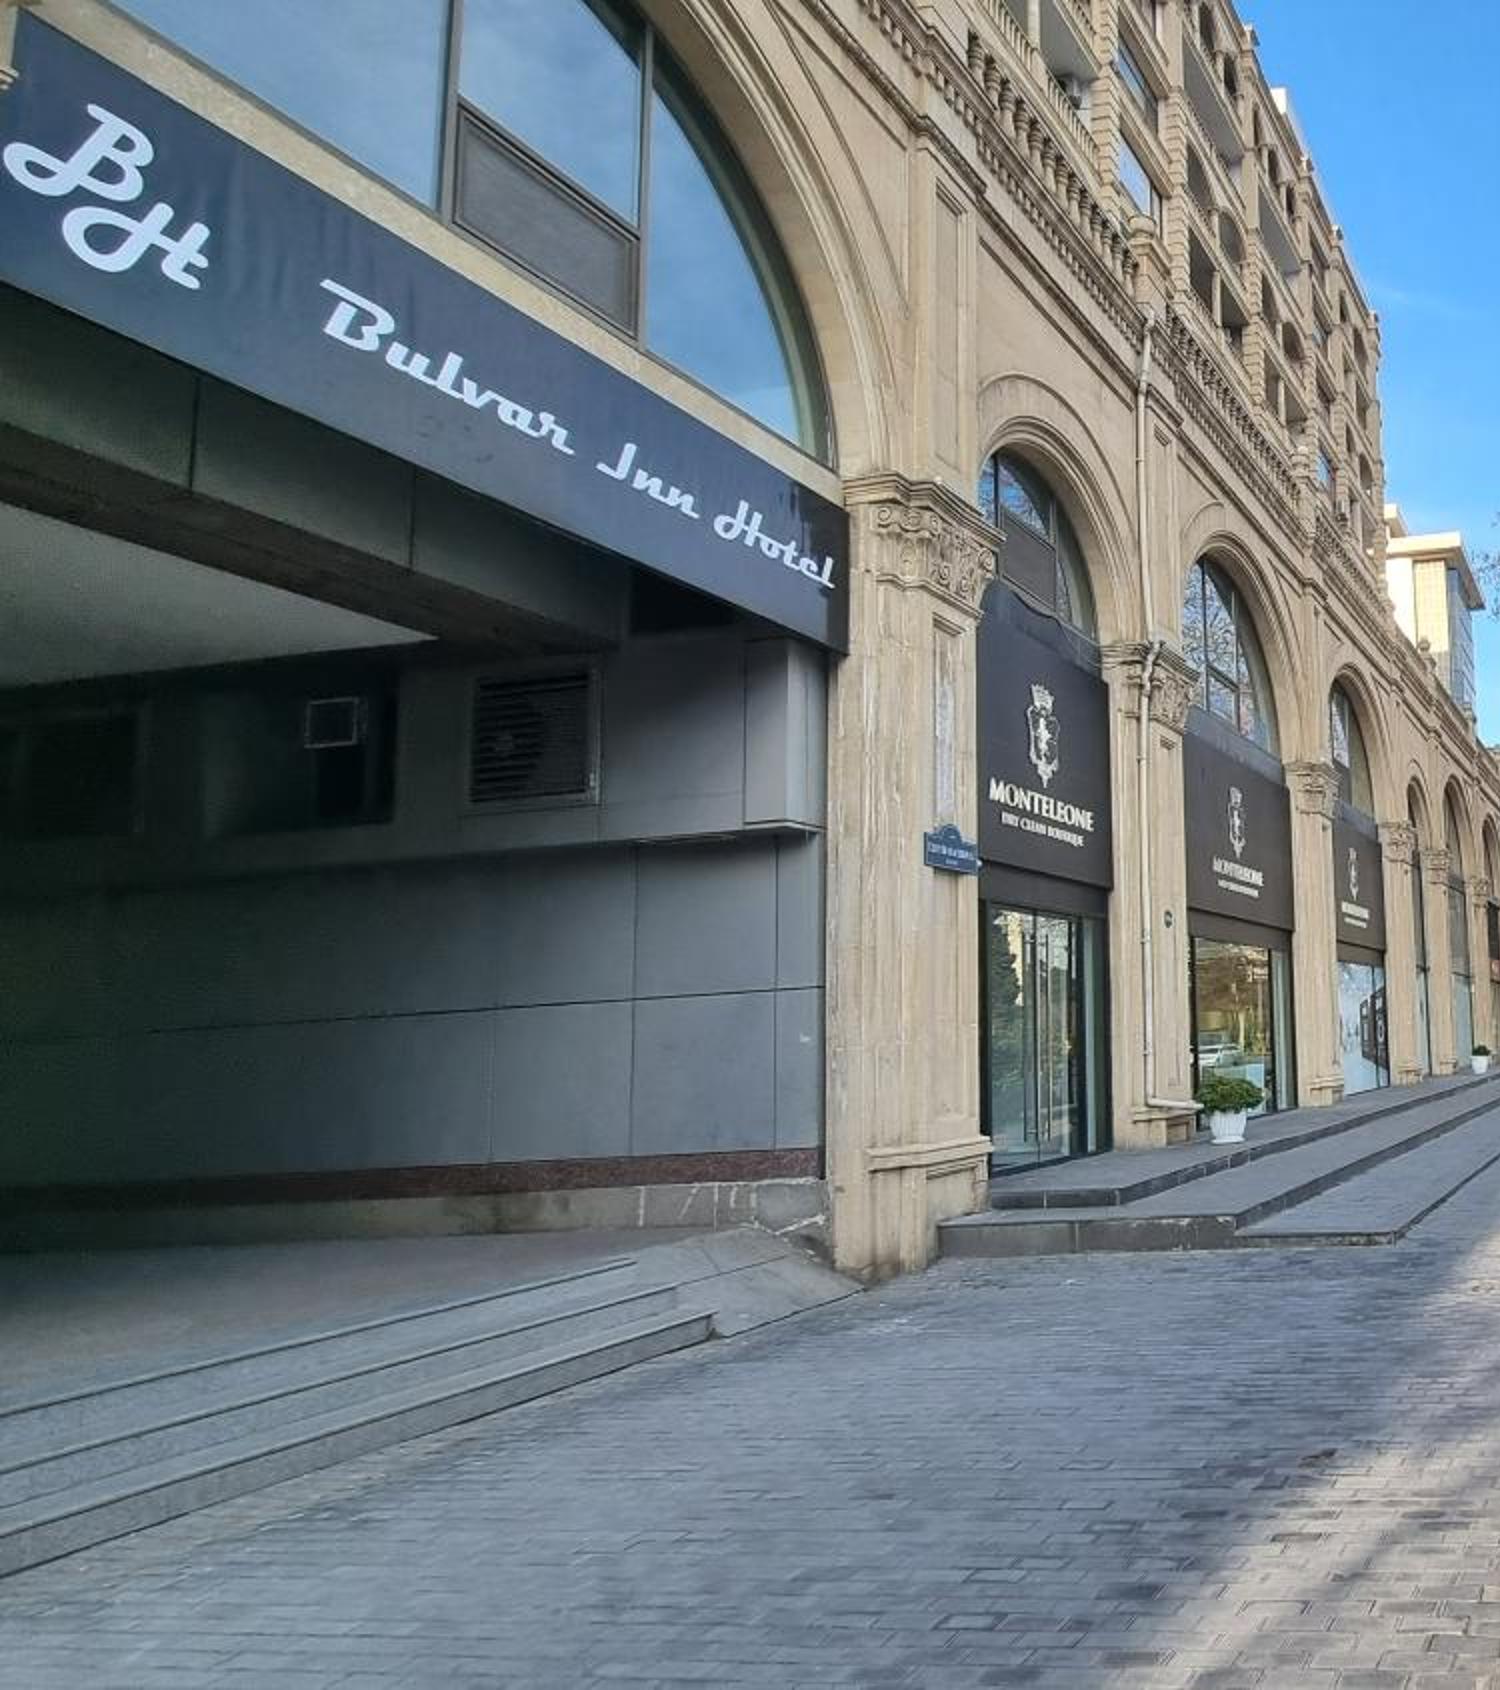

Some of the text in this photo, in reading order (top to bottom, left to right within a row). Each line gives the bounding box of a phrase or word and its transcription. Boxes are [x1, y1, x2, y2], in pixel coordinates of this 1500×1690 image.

[320, 279, 835, 589] Bulvar Inn Hotel
[989, 777, 1094, 831] MONTELEONE
